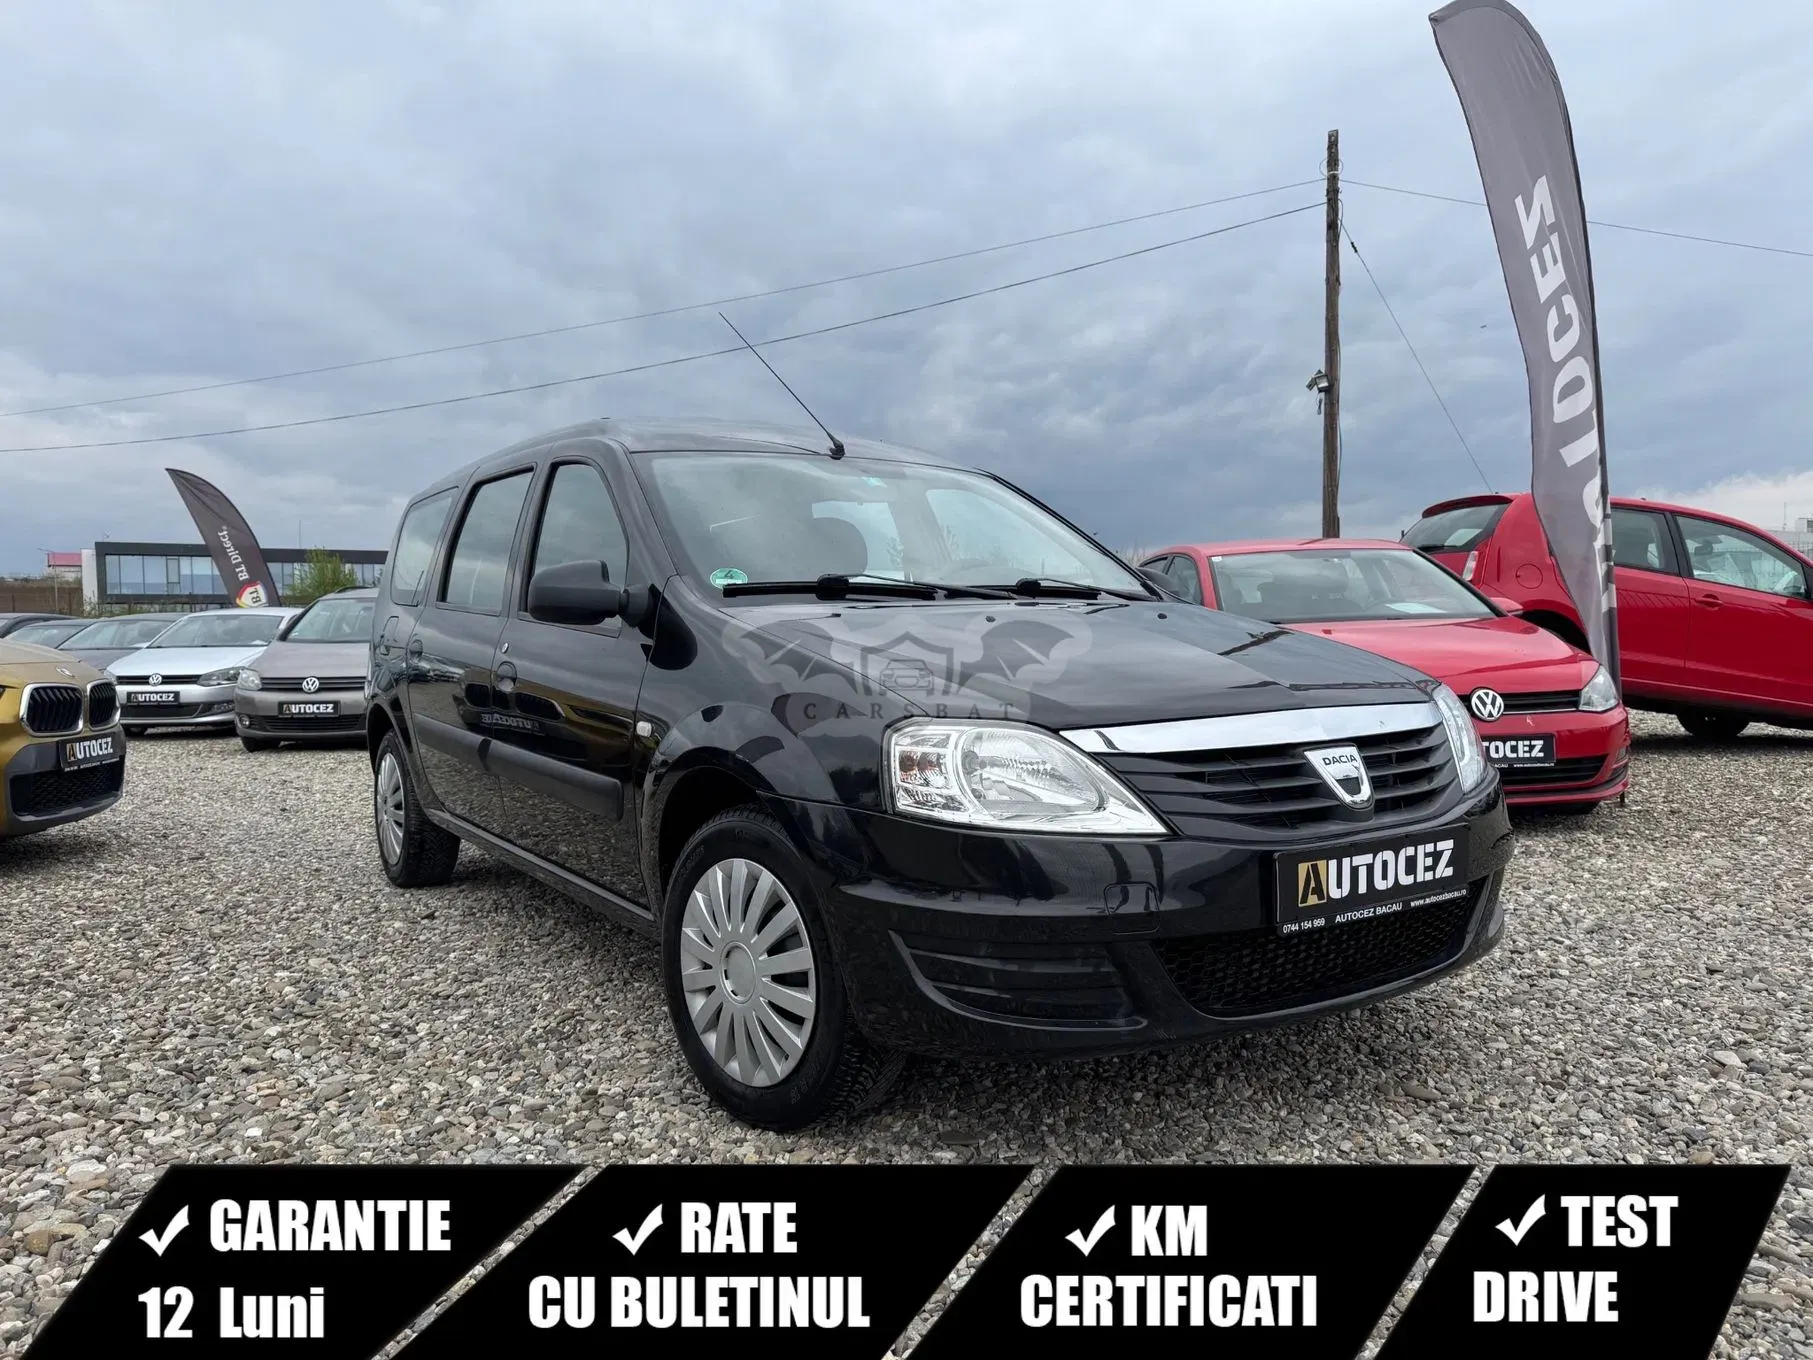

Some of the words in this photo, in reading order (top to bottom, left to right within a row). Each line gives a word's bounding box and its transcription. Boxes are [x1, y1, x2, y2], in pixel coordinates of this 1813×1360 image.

[130, 693, 175, 703] AUTOCEZ
[282, 703, 335, 714] AUTOCEZ
[66, 737, 114, 761] AUTOCEZ
[1321, 754, 1358, 766] DACIA
[1298, 838, 1455, 907] AUTOCEZ
[1282, 922, 1299, 934] 0744
[1300, 920, 1312, 931] 154
[1313, 917, 1326, 928] 959
[1335, 908, 1375, 924] AUTOCEZ
[1376, 902, 1403, 916] BACAU
[1410, 888, 1467, 908] www.autocezbacau.ro
